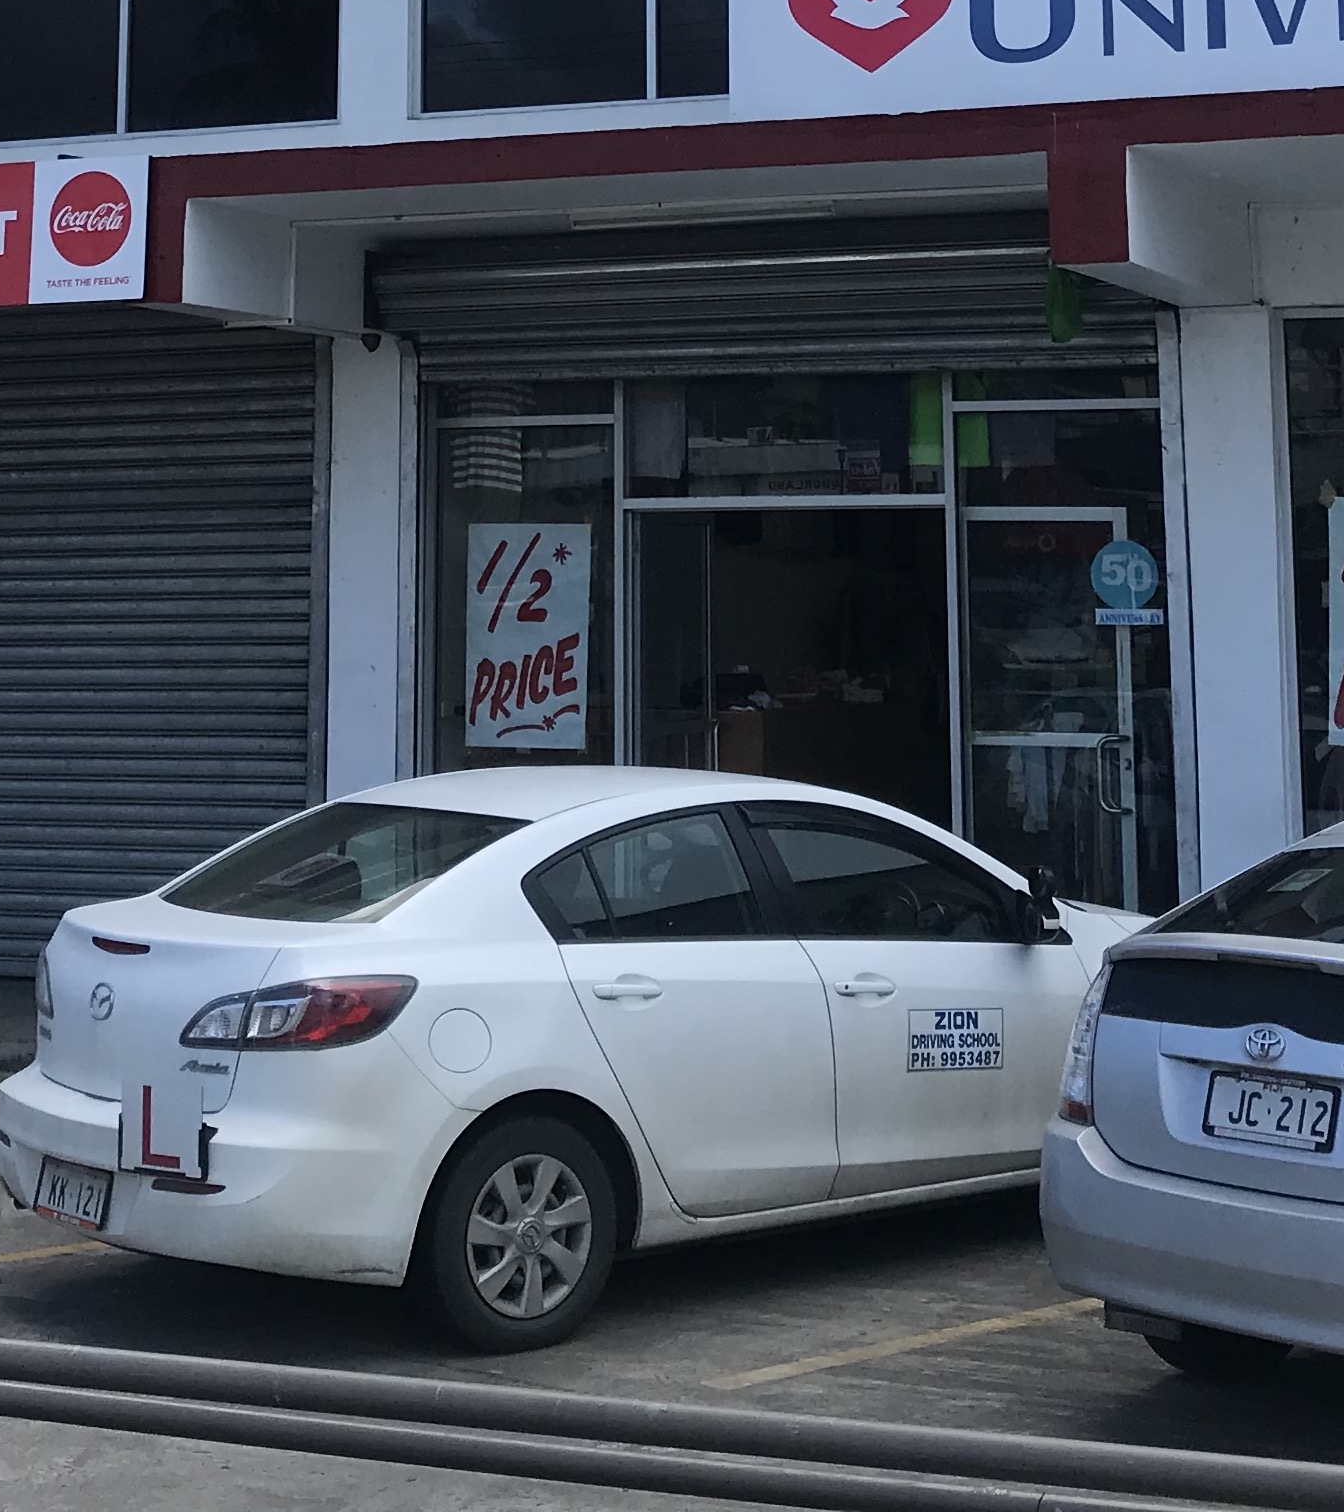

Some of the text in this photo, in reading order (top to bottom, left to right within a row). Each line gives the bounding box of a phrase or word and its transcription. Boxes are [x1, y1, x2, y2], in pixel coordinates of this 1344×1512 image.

[53, 202, 128, 234] Coca-Cola
[46, 276, 130, 289] TASTE THE FEELING
[469, 632, 581, 726] PRICE
[934, 1011, 979, 1030] ZION
[911, 1033, 1000, 1050] DRIVING SCHOOL
[911, 1051, 1000, 1068] PH: 9953487
[142, 1085, 181, 1169] L
